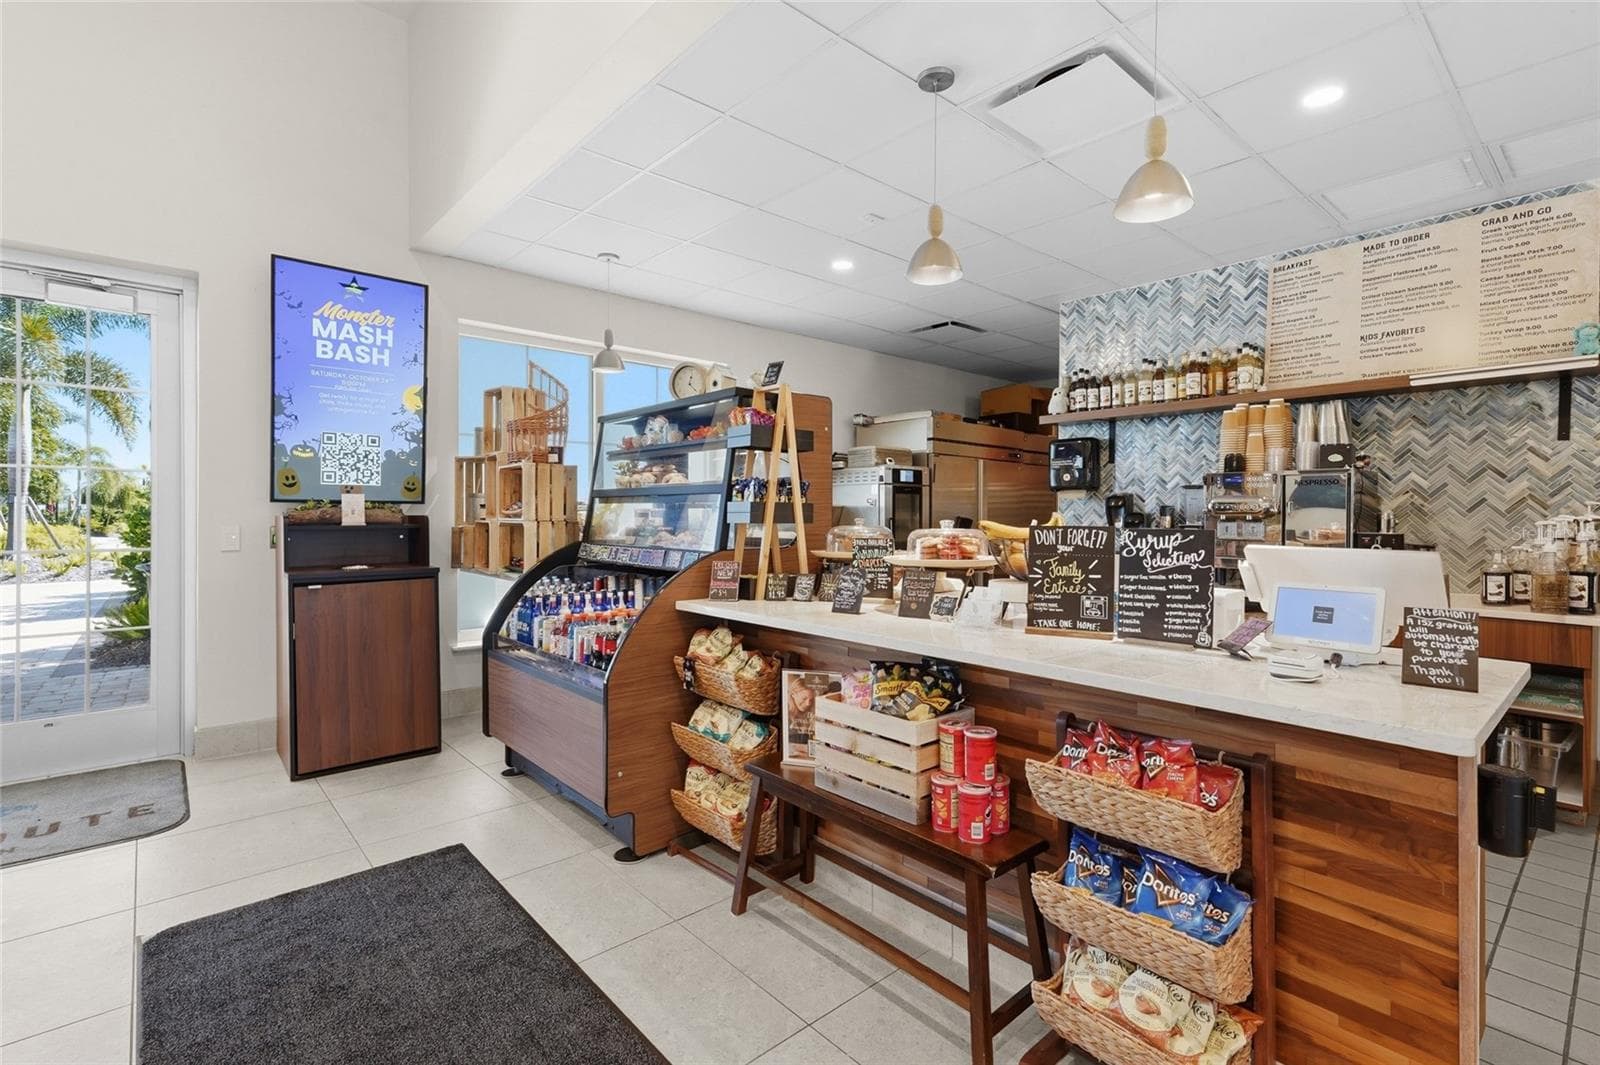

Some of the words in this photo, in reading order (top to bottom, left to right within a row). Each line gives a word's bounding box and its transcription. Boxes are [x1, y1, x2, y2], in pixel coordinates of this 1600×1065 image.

[1482, 216, 1509, 226] GRAB
[1512, 210, 1533, 220] AND
[1537, 206, 1551, 215] GO
[1504, 222, 1528, 230] Yogurt
[1530, 216, 1554, 224] Parfait
[1363, 242, 1385, 253] MADE
[1390, 239, 1399, 247] TO
[1402, 232, 1430, 244] ORDER
[1273, 259, 1312, 273] BREAKFAST
[313, 301, 395, 328] Monster
[313, 318, 393, 347] MASH
[1360, 332, 1378, 342] KIDS
[1380, 326, 1426, 340] FAVORITES
[316, 339, 389, 367] BASH
[1034, 528, 1063, 545] DON'T
[1067, 528, 1107, 549] FORGET!
[1122, 531, 1193, 557] Syrup
[1057, 545, 1074, 553] your
[1143, 549, 1205, 567] Selection
[1043, 556, 1085, 583] Family
[1044, 578, 1087, 594] Entree
[1037, 619, 1058, 627] TAKE
[1077, 621, 1097, 630] HOME
[1418, 619, 1434, 627] 15%
[1436, 621, 1479, 634] gratuity
[1404, 632, 1479, 648] automatically
[1431, 641, 1475, 652] charged
[1412, 655, 1469, 665] purchase
[1410, 665, 1454, 676] Thank
[1428, 676, 1452, 684] You
[875, 683, 903, 695] Smart
[0, 803, 155, 844] UTE
[1069, 850, 1110, 877] Doritos
[1142, 871, 1196, 906] Doritos
